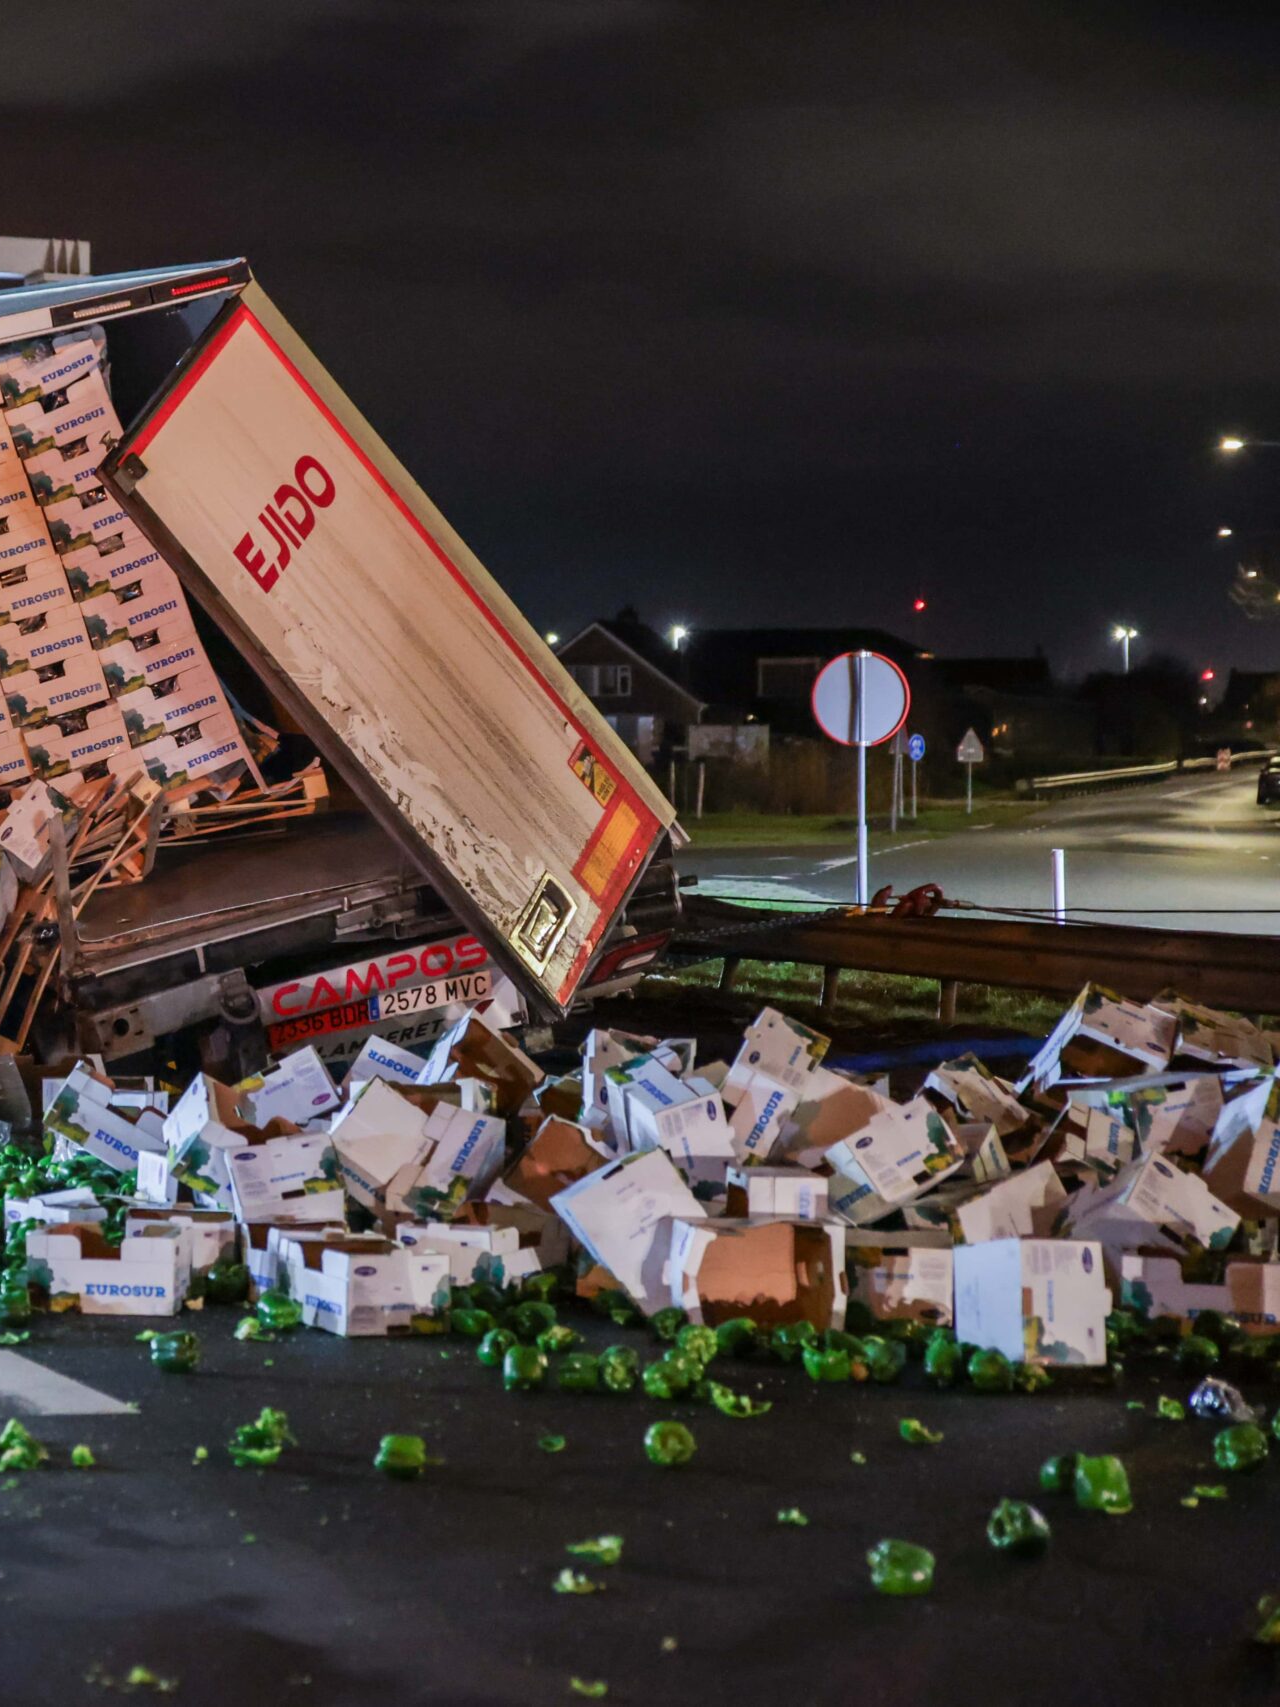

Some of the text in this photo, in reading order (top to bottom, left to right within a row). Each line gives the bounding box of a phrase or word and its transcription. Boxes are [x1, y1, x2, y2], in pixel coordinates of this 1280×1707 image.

[41, 353, 94, 384] EUROSUR
[92, 510, 129, 531] EUROS
[233, 455, 336, 594] EJIDO
[11, 587, 66, 610] EUROSUR
[30, 634, 84, 658] EUROSUR
[49, 682, 103, 706] EUROSUR
[165, 695, 217, 721] EUROSUR
[71, 735, 124, 758] EUROSUR
[187, 741, 239, 768] EUROSUR
[271, 936, 488, 1016] CAMPOS
[384, 985, 437, 1015] 2578
[444, 976, 488, 1001] MVC
[330, 1002, 369, 1028] BDR
[318, 1018, 445, 1058] LAMERET
[368, 1049, 420, 1082] UROSUR
[745, 1090, 784, 1149] EUROSUR
[94, 1128, 139, 1160] EUROS
[451, 1119, 487, 1172] EUROSUR
[85, 1283, 166, 1298] EUROSUR
